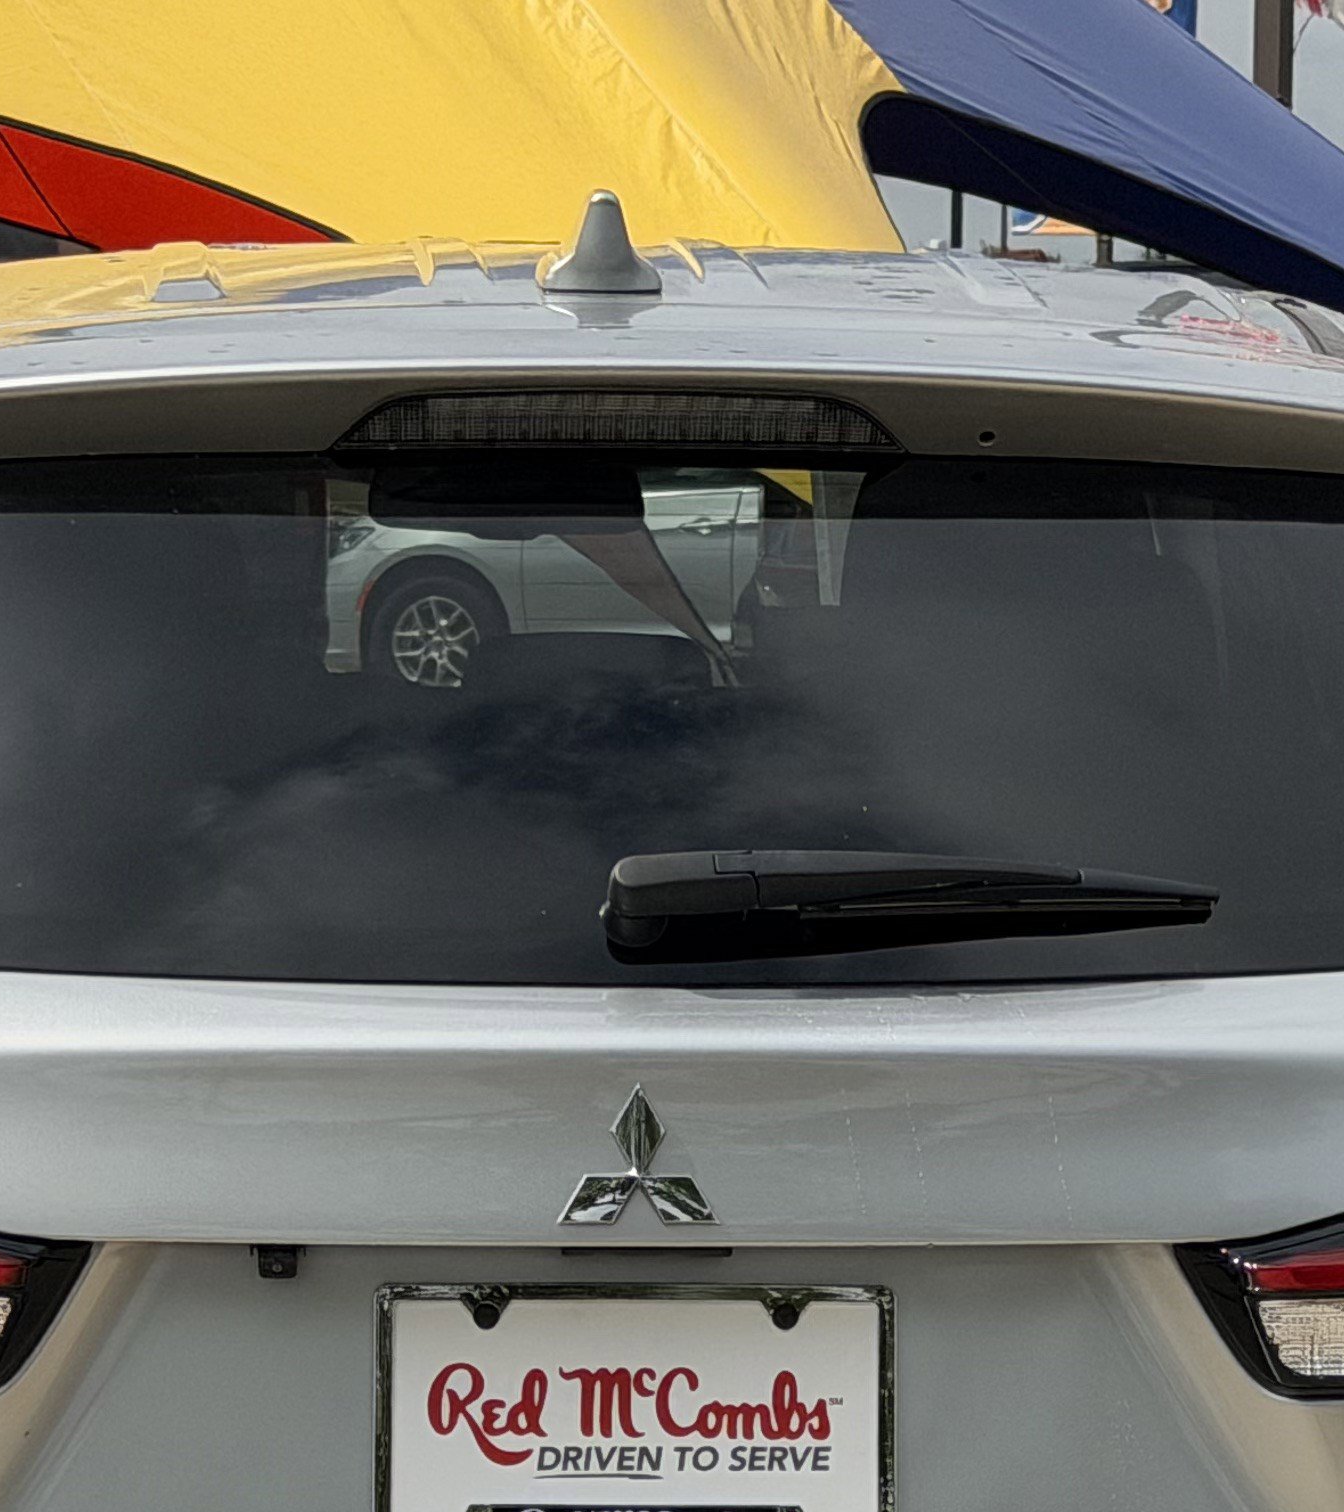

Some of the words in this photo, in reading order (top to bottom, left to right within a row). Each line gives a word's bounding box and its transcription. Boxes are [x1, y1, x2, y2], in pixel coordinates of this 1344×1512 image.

[426, 1362, 548, 1466] Red
[559, 1366, 832, 1441] McCombs
[536, 1446, 663, 1473] DRIVEN
[675, 1446, 720, 1472] TO
[729, 1445, 832, 1472] SERVE
